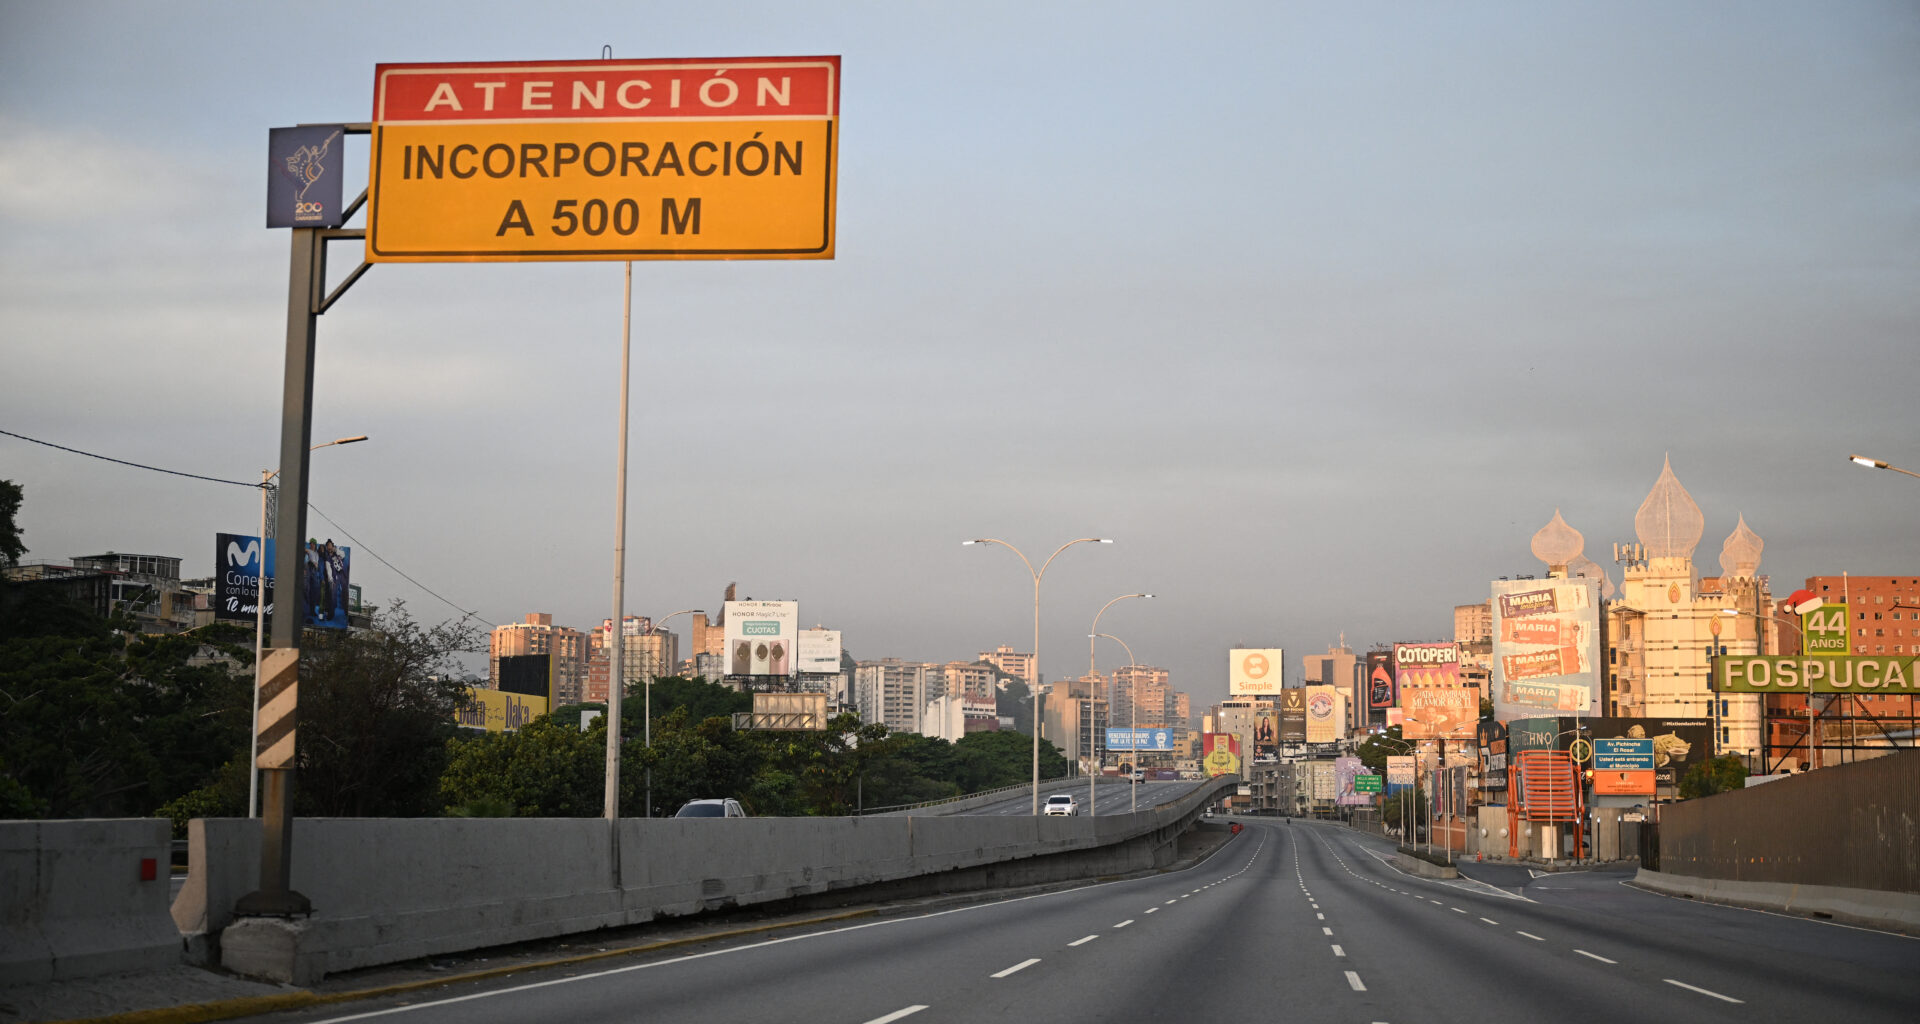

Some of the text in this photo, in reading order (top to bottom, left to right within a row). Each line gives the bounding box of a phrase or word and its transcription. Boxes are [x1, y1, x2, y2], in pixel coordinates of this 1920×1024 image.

[424, 69, 791, 112] ATENCIÓN
[403, 132, 803, 180] INCORPORACIÓN
[295, 202, 323, 213] 200
[495, 197, 702, 237] A 500 M
[226, 570, 275, 589] Coneta
[226, 586, 241, 596] con
[241, 587, 250, 596] lo
[226, 596, 274, 615] Te muve
[1509, 592, 1552, 607] MARIA
[746, 626, 776, 634] CUOTAS
[1515, 623, 1557, 633] MARIA
[1807, 611, 1846, 636] 44
[1810, 637, 1845, 649] AÑOS
[1397, 645, 1458, 663] COTOPERÍ
[1515, 652, 1558, 665] MARIA
[1724, 659, 1920, 689] FOSPUCA
[1239, 682, 1273, 692] Simple
[1516, 686, 1556, 697] MARIA
[505, 695, 530, 729] Daka
